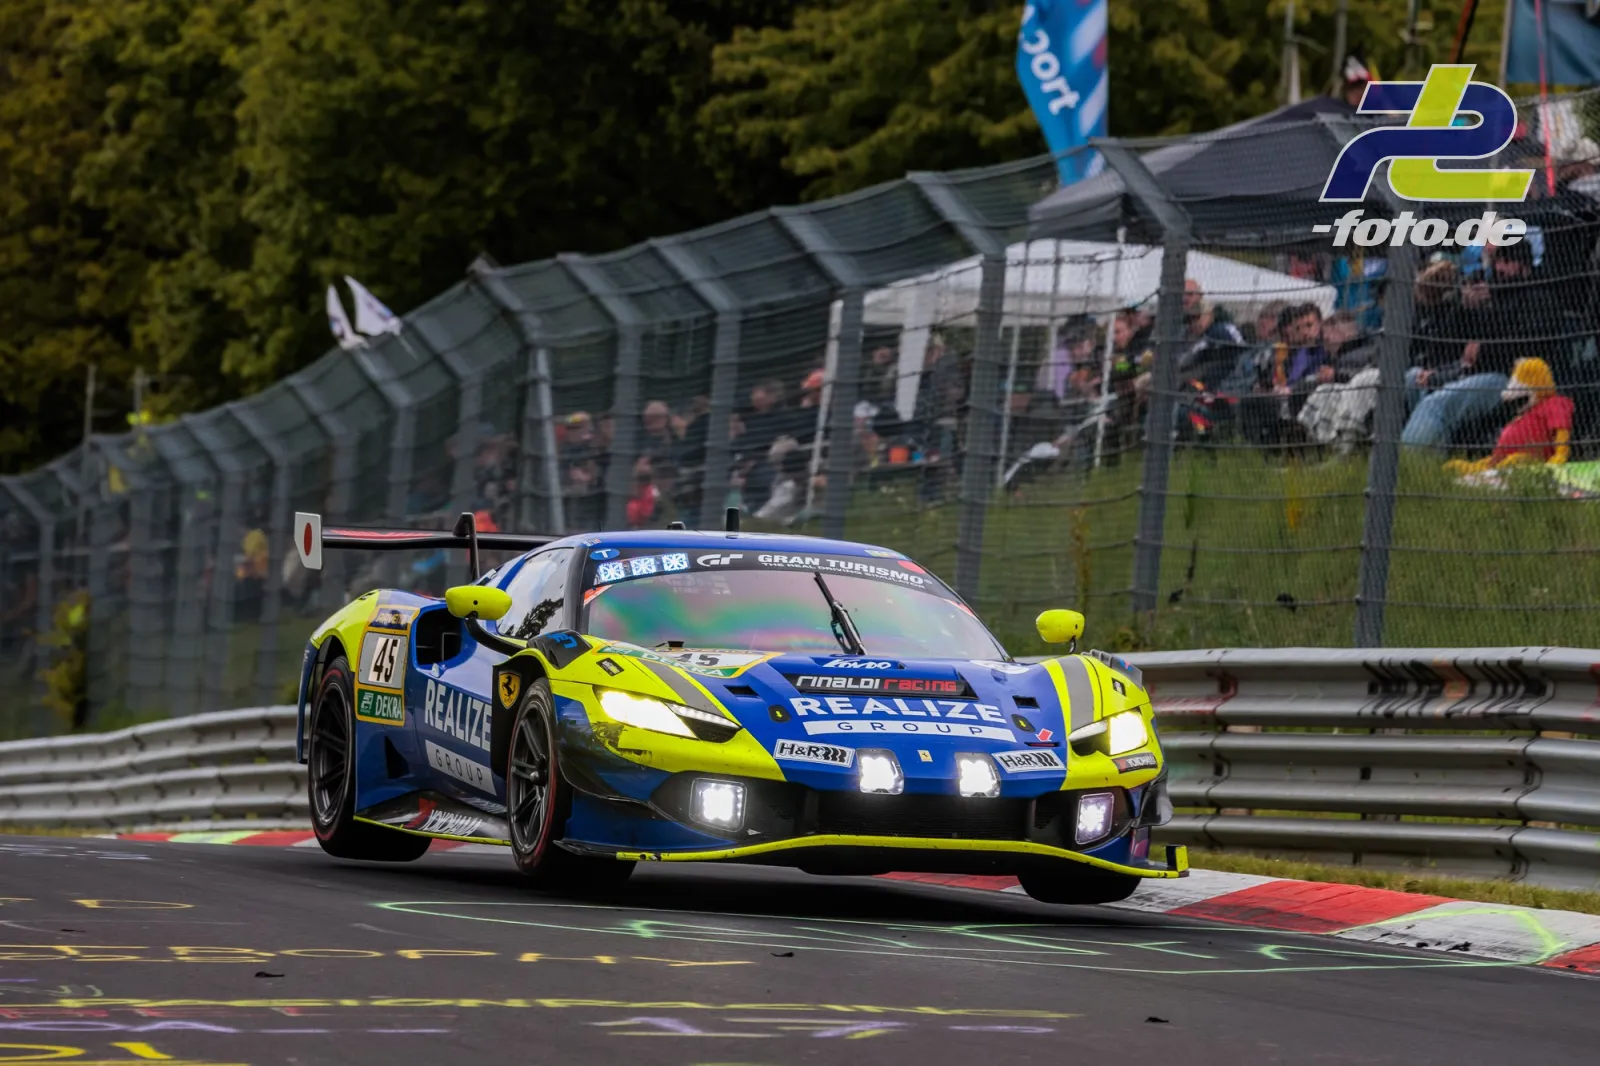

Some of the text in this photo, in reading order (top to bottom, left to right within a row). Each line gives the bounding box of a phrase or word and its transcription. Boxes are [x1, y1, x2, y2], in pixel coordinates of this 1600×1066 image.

[758, 554, 820, 566] GRAN
[826, 559, 925, 585] TURISMO
[817, 565, 862, 576] DRIVING
[373, 638, 399, 682] 45
[375, 694, 403, 720] DEKRA
[425, 679, 492, 752] REALIZE
[789, 697, 1007, 724] REALIZE
[838, 721, 983, 735] GROUP
[779, 742, 820, 758] H&R
[1000, 753, 1039, 768] H&R
[435, 749, 483, 786] GROUP
